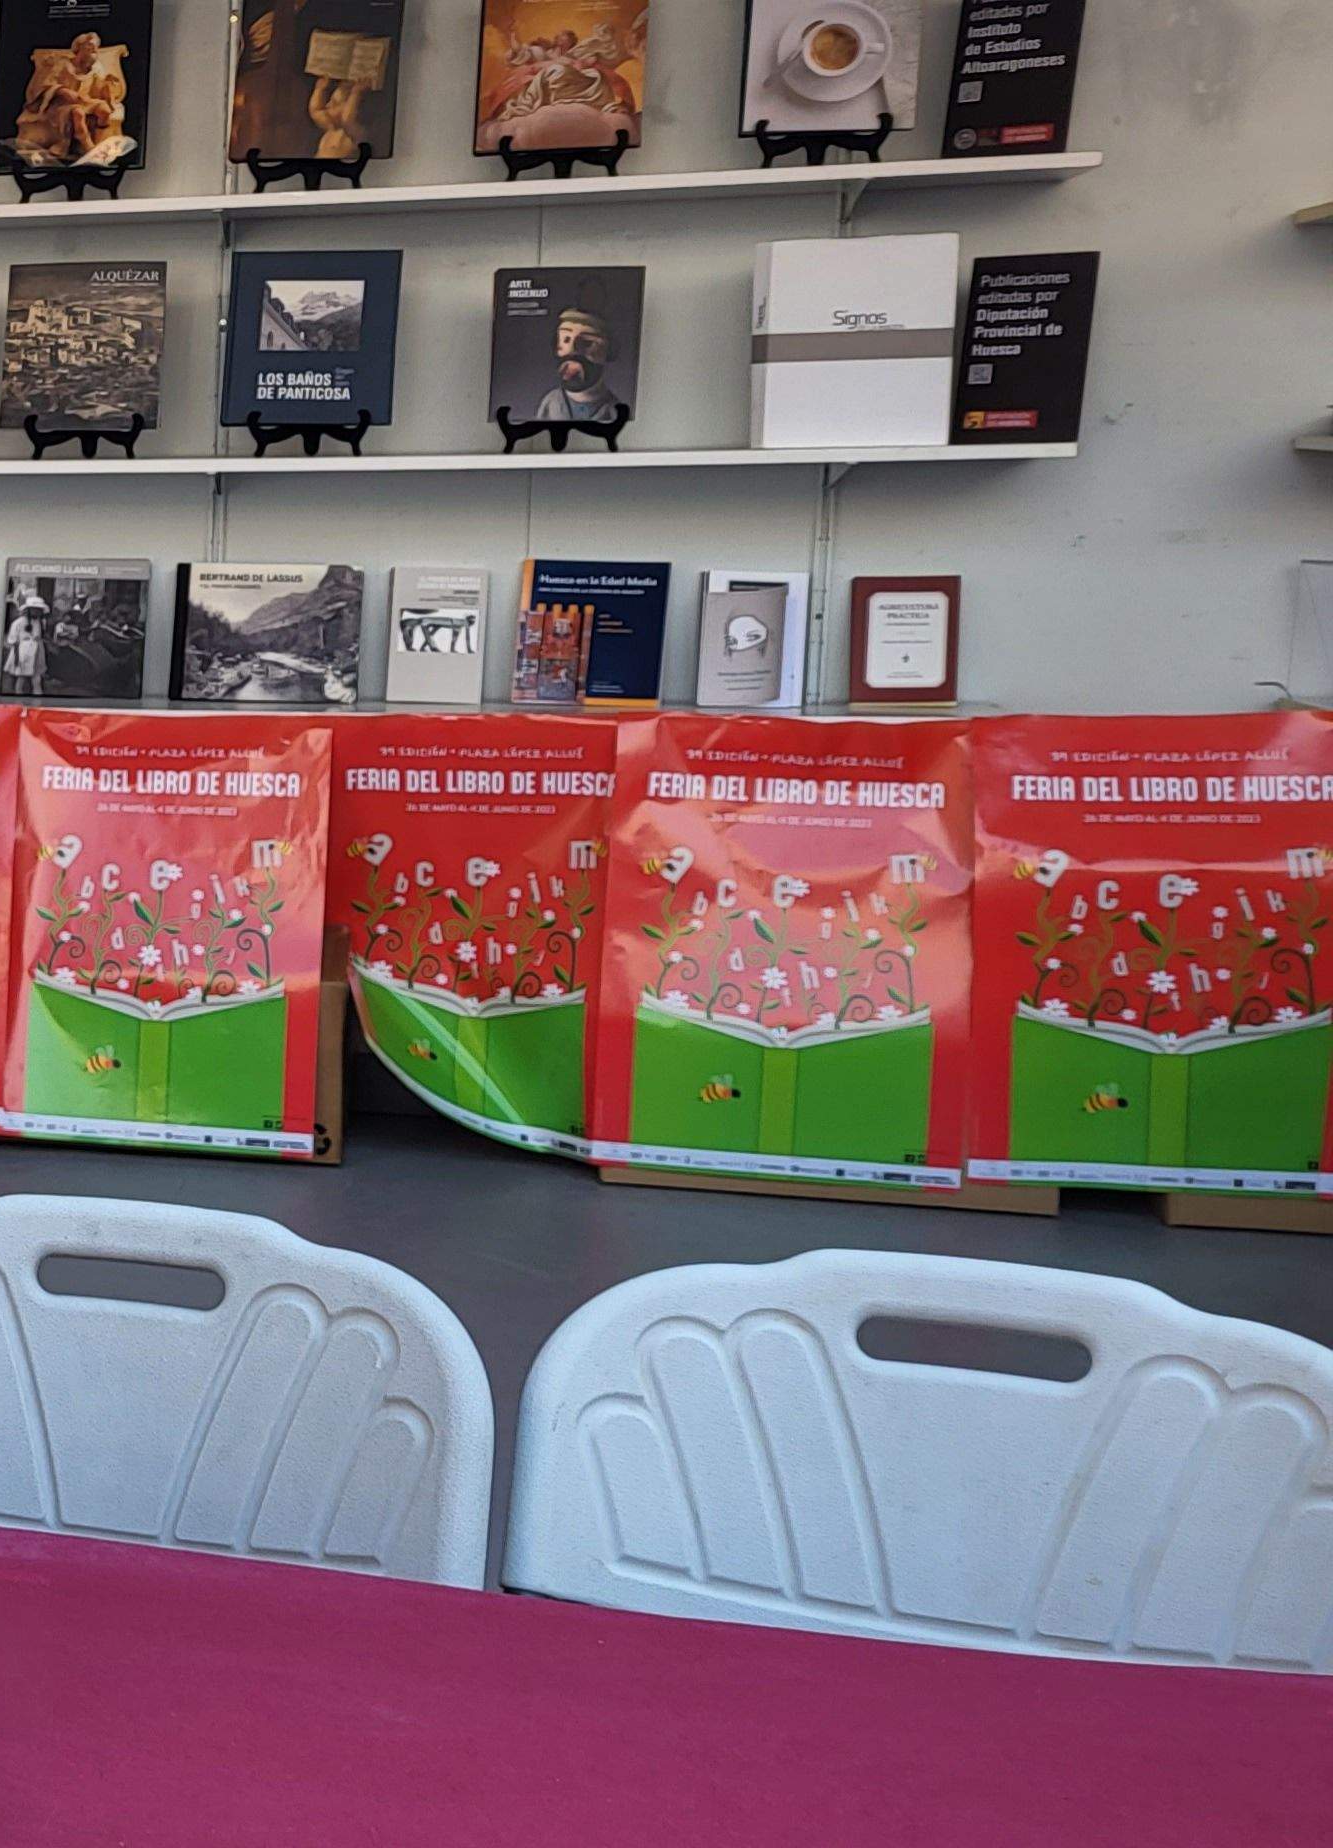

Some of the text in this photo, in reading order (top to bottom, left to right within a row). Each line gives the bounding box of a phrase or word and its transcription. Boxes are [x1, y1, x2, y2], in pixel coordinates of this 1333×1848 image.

[970, 3, 1050, 21] editadas por
[967, 23, 1022, 38] Instituto
[965, 38, 1042, 56] de Estudios
[961, 54, 1066, 74] Altoaragoneses
[90, 268, 159, 283] ALQUÉZAR
[509, 280, 532, 288] ARTE
[981, 273, 1070, 287] Publicaciones
[978, 290, 1060, 305] editadas por
[830, 309, 888, 330] Signos
[976, 307, 1049, 324] Diputación
[974, 324, 1063, 339] Provincial de
[972, 344, 1021, 356] Huesca
[258, 372, 284, 386] LOS
[288, 371, 332, 386] BAÑOS
[256, 386, 351, 400] DE PANTICOSA
[199, 573, 303, 583] BERTRAND DE LASSUS
[76, 747, 89, 755] 39
[379, 747, 395, 756] 39
[399, 746, 448, 756] EDICIÓN
[459, 748, 500, 758] PLAZA
[503, 746, 542, 758] LÓPEZ
[1051, 751, 1068, 761] 39
[1074, 750, 1129, 762] EDICIÓN
[1145, 752, 1190, 762] PLAZA
[1196, 750, 1238, 762] LÓPEZ
[42, 765, 300, 797] FERIA DEL LIBRO DE HUESCA
[346, 768, 400, 792] FERIA
[405, 770, 441, 793] DEL
[445, 770, 504, 794] LIBRO
[510, 772, 536, 795] DE
[648, 772, 945, 808] FERIA DEL LIBRO DE HUESCA
[1012, 775, 1333, 802] FERIA DEL LIBRO DE HUESCA
[53, 834, 83, 869] a
[252, 839, 282, 868] m
[1034, 849, 1070, 887] a
[1286, 848, 1325, 879] m
[101, 863, 120, 891] c
[150, 859, 171, 891] e
[1097, 880, 1120, 910] c
[1159, 874, 1183, 909] e
